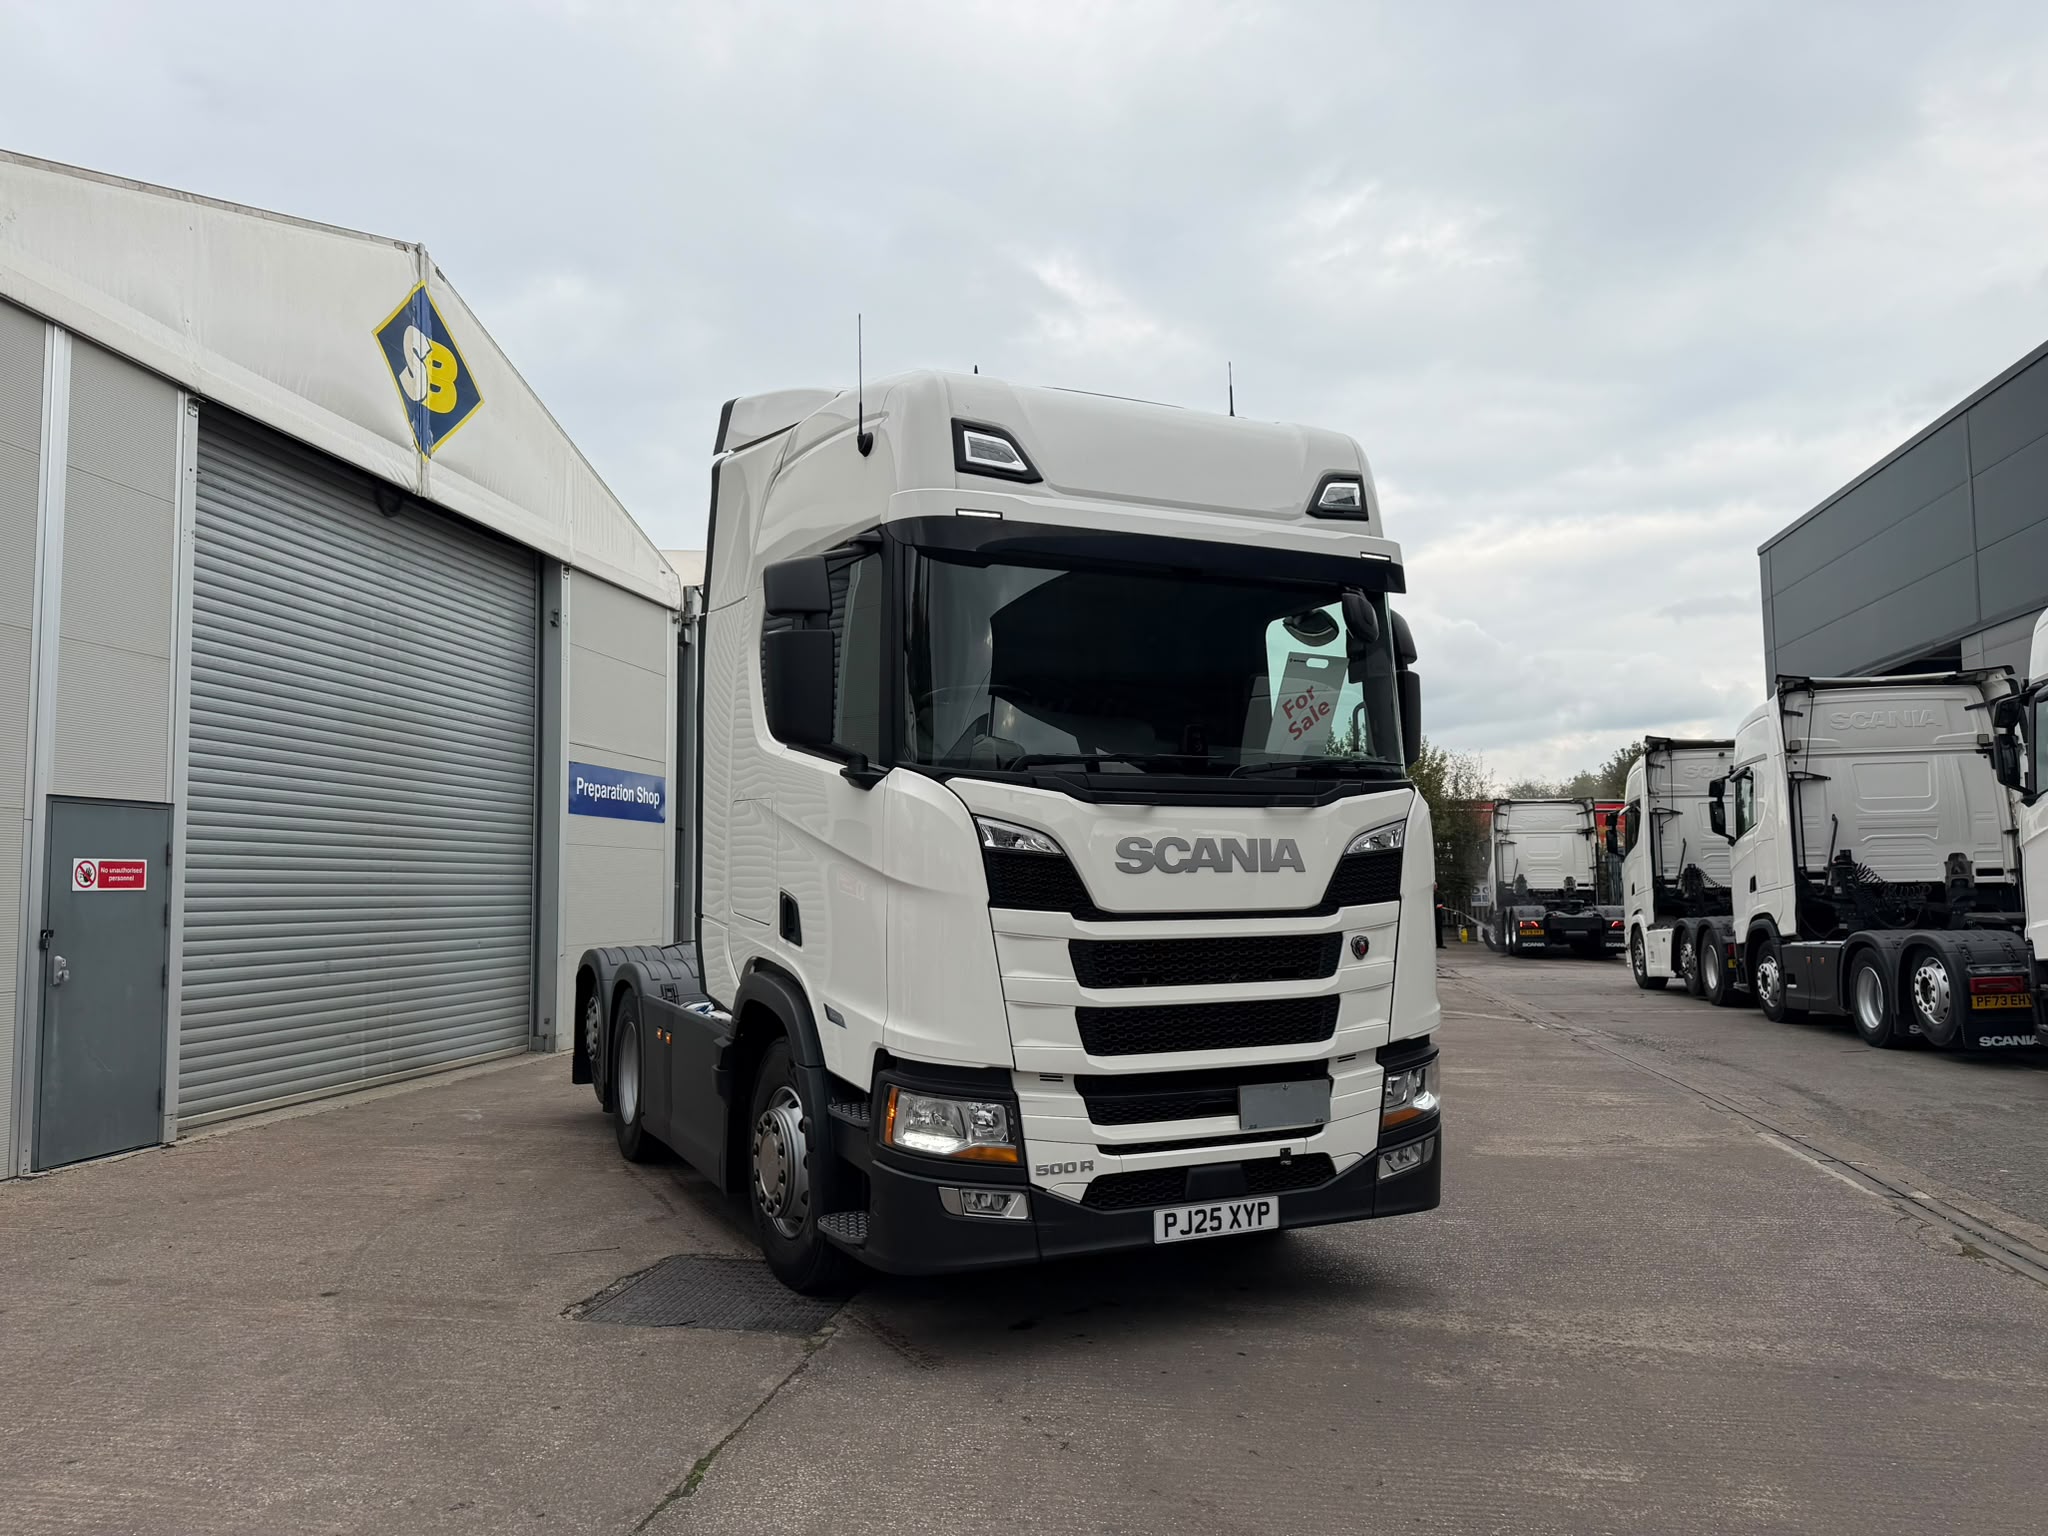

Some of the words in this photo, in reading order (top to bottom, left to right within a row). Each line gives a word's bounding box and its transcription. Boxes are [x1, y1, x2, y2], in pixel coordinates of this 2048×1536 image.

[399, 325, 458, 414] SB
[1282, 685, 1316, 719] For
[1288, 700, 1331, 741] Sale
[1830, 710, 1943, 731] SCANIA
[576, 777, 634, 802] Preparation
[637, 786, 660, 809] Shop
[1115, 836, 1306, 874] SCANIA
[1976, 996, 2008, 1007] PF73
[1979, 1035, 2041, 1047] SCANIA
[1036, 1162, 1077, 1176] 500
[1080, 1160, 1094, 1172] R
[1164, 1207, 1222, 1238] PJ25
[1229, 1201, 1270, 1229] XYP
